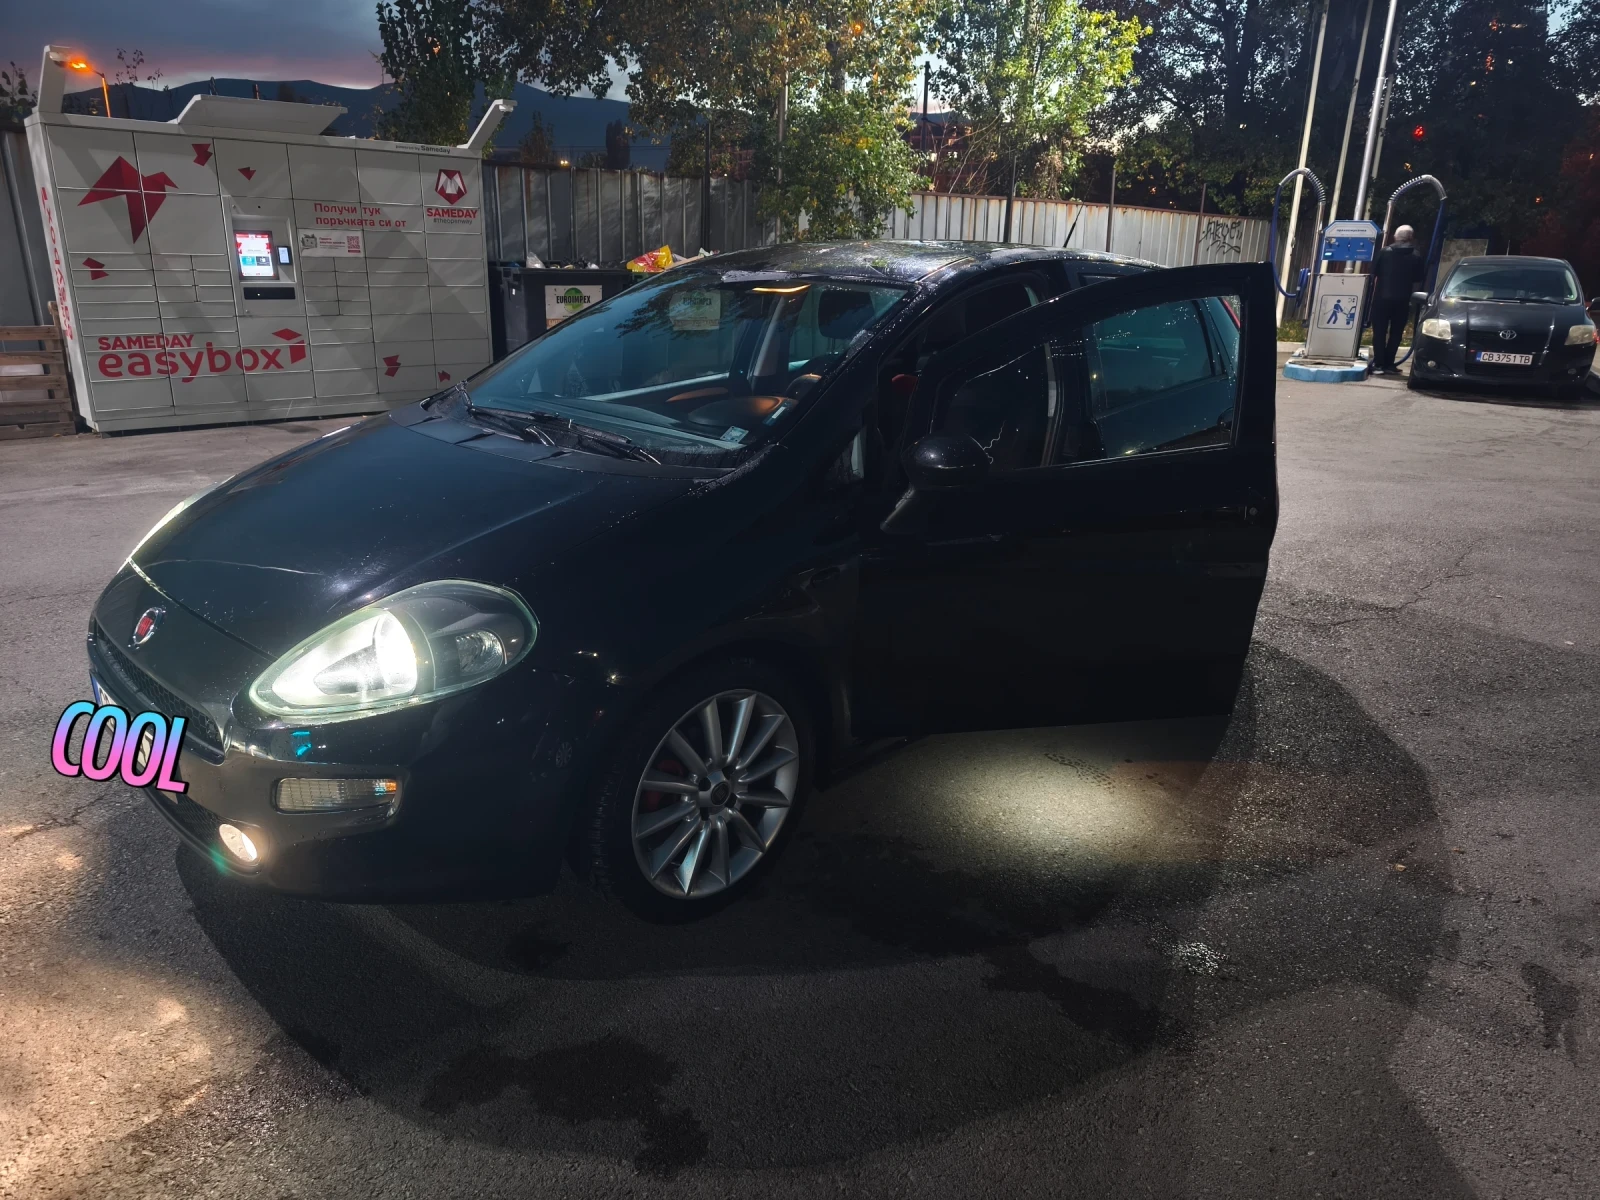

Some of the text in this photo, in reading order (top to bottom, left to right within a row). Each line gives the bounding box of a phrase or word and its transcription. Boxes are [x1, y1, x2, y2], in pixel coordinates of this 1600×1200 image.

[421, 145, 451, 154] Sameday
[314, 203, 381, 217] Получи тук
[426, 208, 478, 219] SAMEDAY
[315, 217, 375, 227] поръчката
[379, 219, 391, 227] си
[556, 295, 591, 304] EUROIMPEX
[98, 334, 194, 350] SAMEDAY
[98, 342, 284, 383] easybox
[1482, 353, 1531, 364] CB 3751 TB
